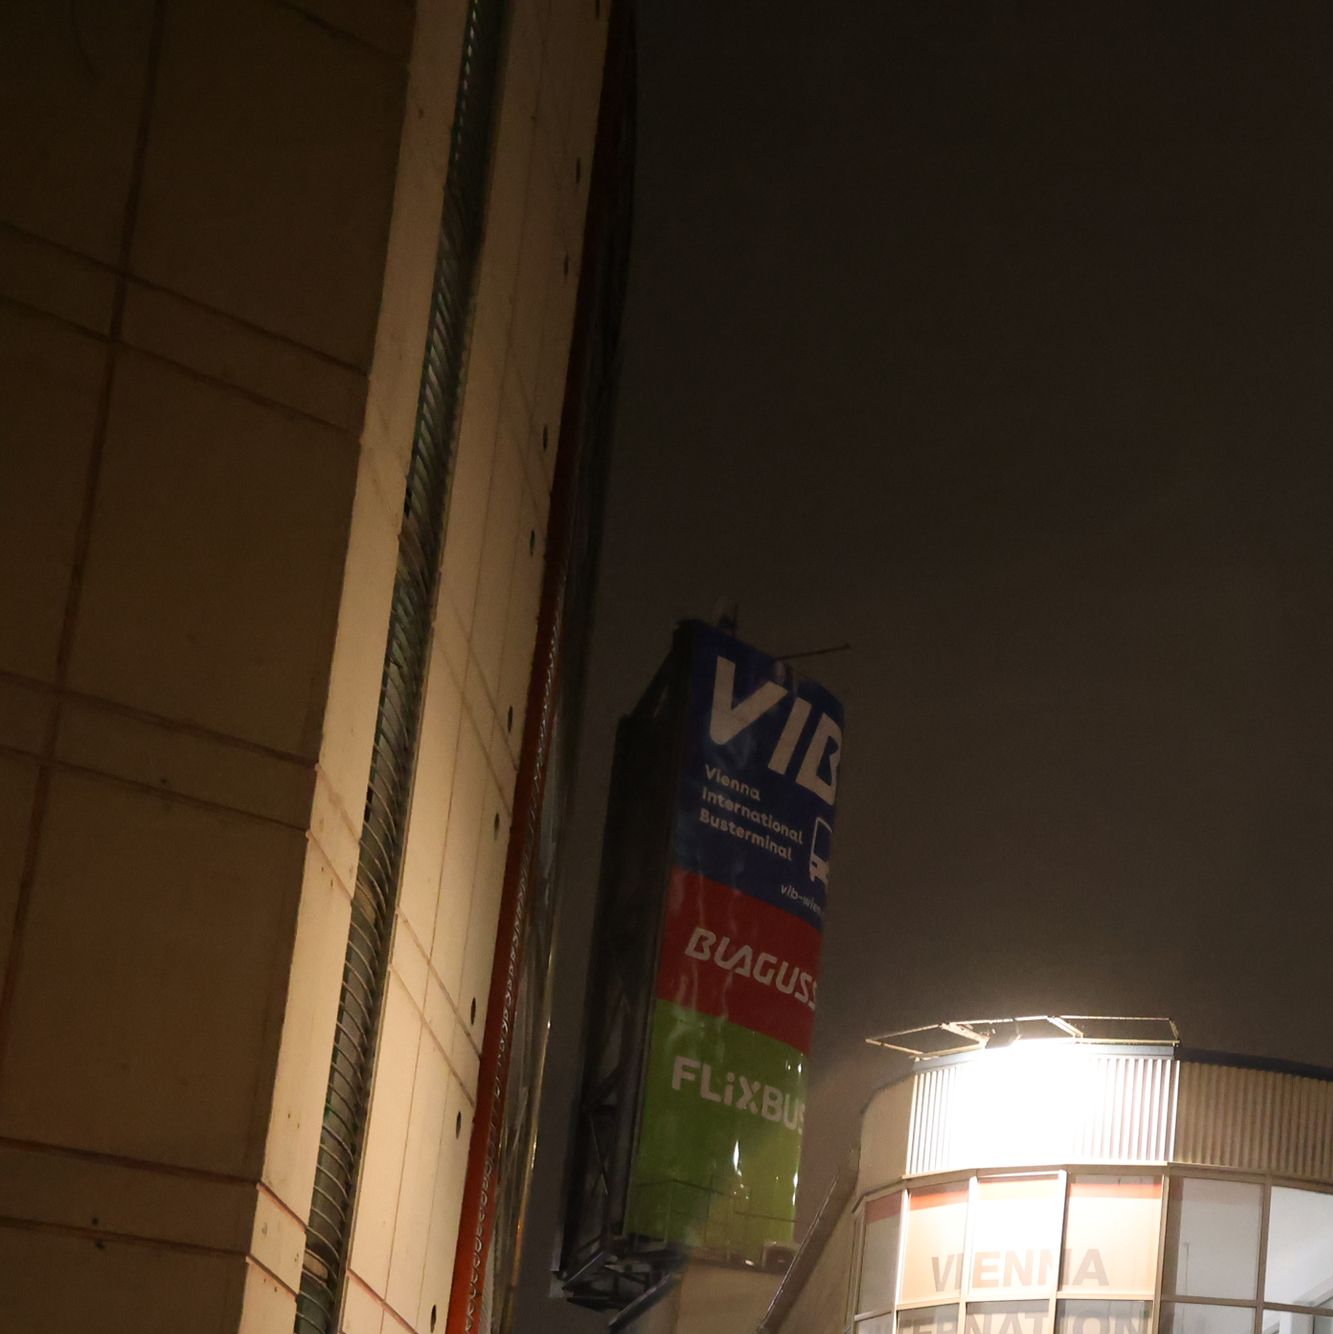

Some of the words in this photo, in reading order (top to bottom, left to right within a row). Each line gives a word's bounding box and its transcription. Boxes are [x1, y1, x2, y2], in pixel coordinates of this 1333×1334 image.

[708, 655, 843, 806] VIB
[704, 763, 761, 802] Vienna
[698, 808, 793, 862] Busterminal
[701, 787, 804, 845] International
[931, 1248, 1110, 1293] VIENNA
